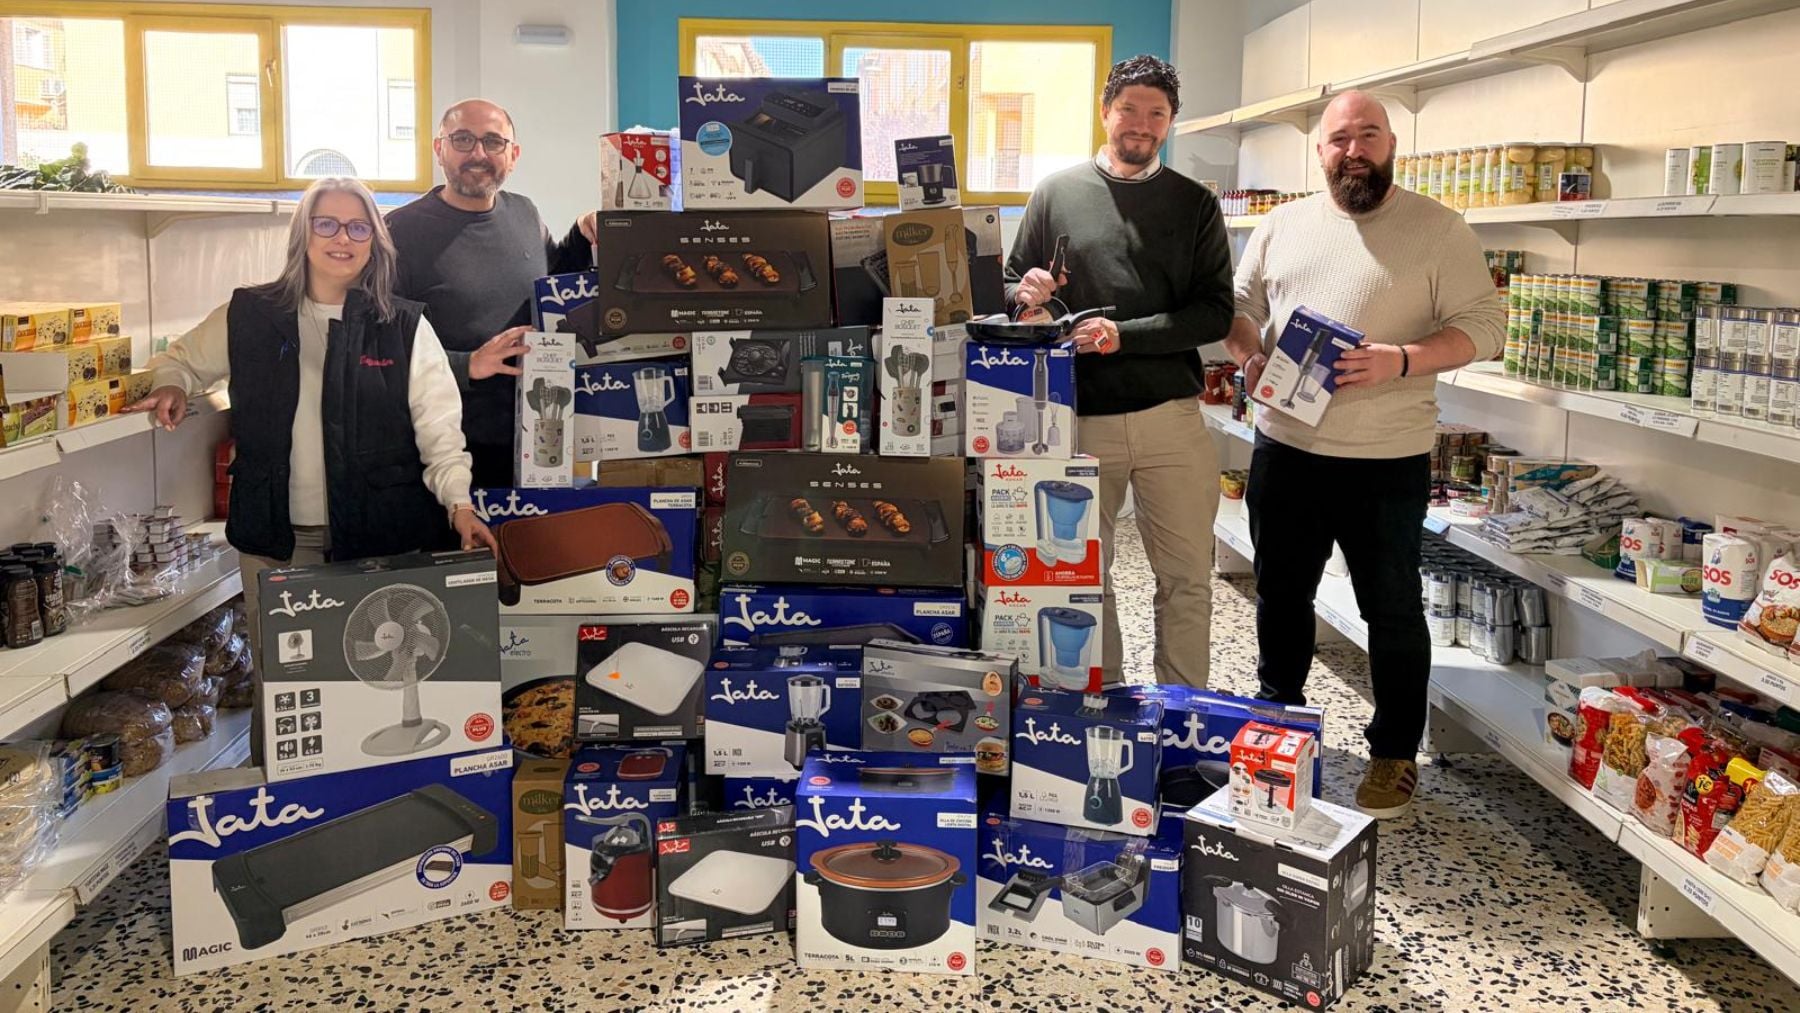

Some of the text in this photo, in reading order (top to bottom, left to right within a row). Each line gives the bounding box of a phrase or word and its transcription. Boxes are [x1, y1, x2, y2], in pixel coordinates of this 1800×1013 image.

[685, 82, 745, 106] Jata
[700, 219, 730, 232] Jata
[895, 302, 922, 314] Jata
[1290, 319, 1313, 334] Jata
[537, 336, 563, 347] Jata
[824, 358, 848, 368] Jata
[971, 345, 1030, 369] Jata
[575, 371, 630, 396] Jata
[831, 462, 861, 475] Jata
[991, 464, 1028, 479] Jata
[809, 481, 882, 489] SENSES
[474, 488, 549, 522] Jata
[1703, 565, 1733, 586] SOS
[1769, 569, 1800, 590] SOS
[269, 589, 344, 617] Jata
[993, 590, 1032, 606] Jata
[723, 593, 822, 632] Jata
[306, 691, 314, 702] 3
[711, 678, 780, 704] Jata
[1015, 717, 1082, 746] Jata
[1162, 713, 1231, 755] ata
[454, 759, 508, 775] PLANCHA ASAR
[816, 754, 866, 764] Jata
[564, 783, 648, 816] Jata
[169, 787, 324, 848] Jata
[796, 795, 901, 838] Jata
[982, 838, 1054, 869] Jata
[1191, 835, 1240, 862] Jata
[1187, 917, 1201, 928] 10
[183, 941, 233, 962] MAGIC
